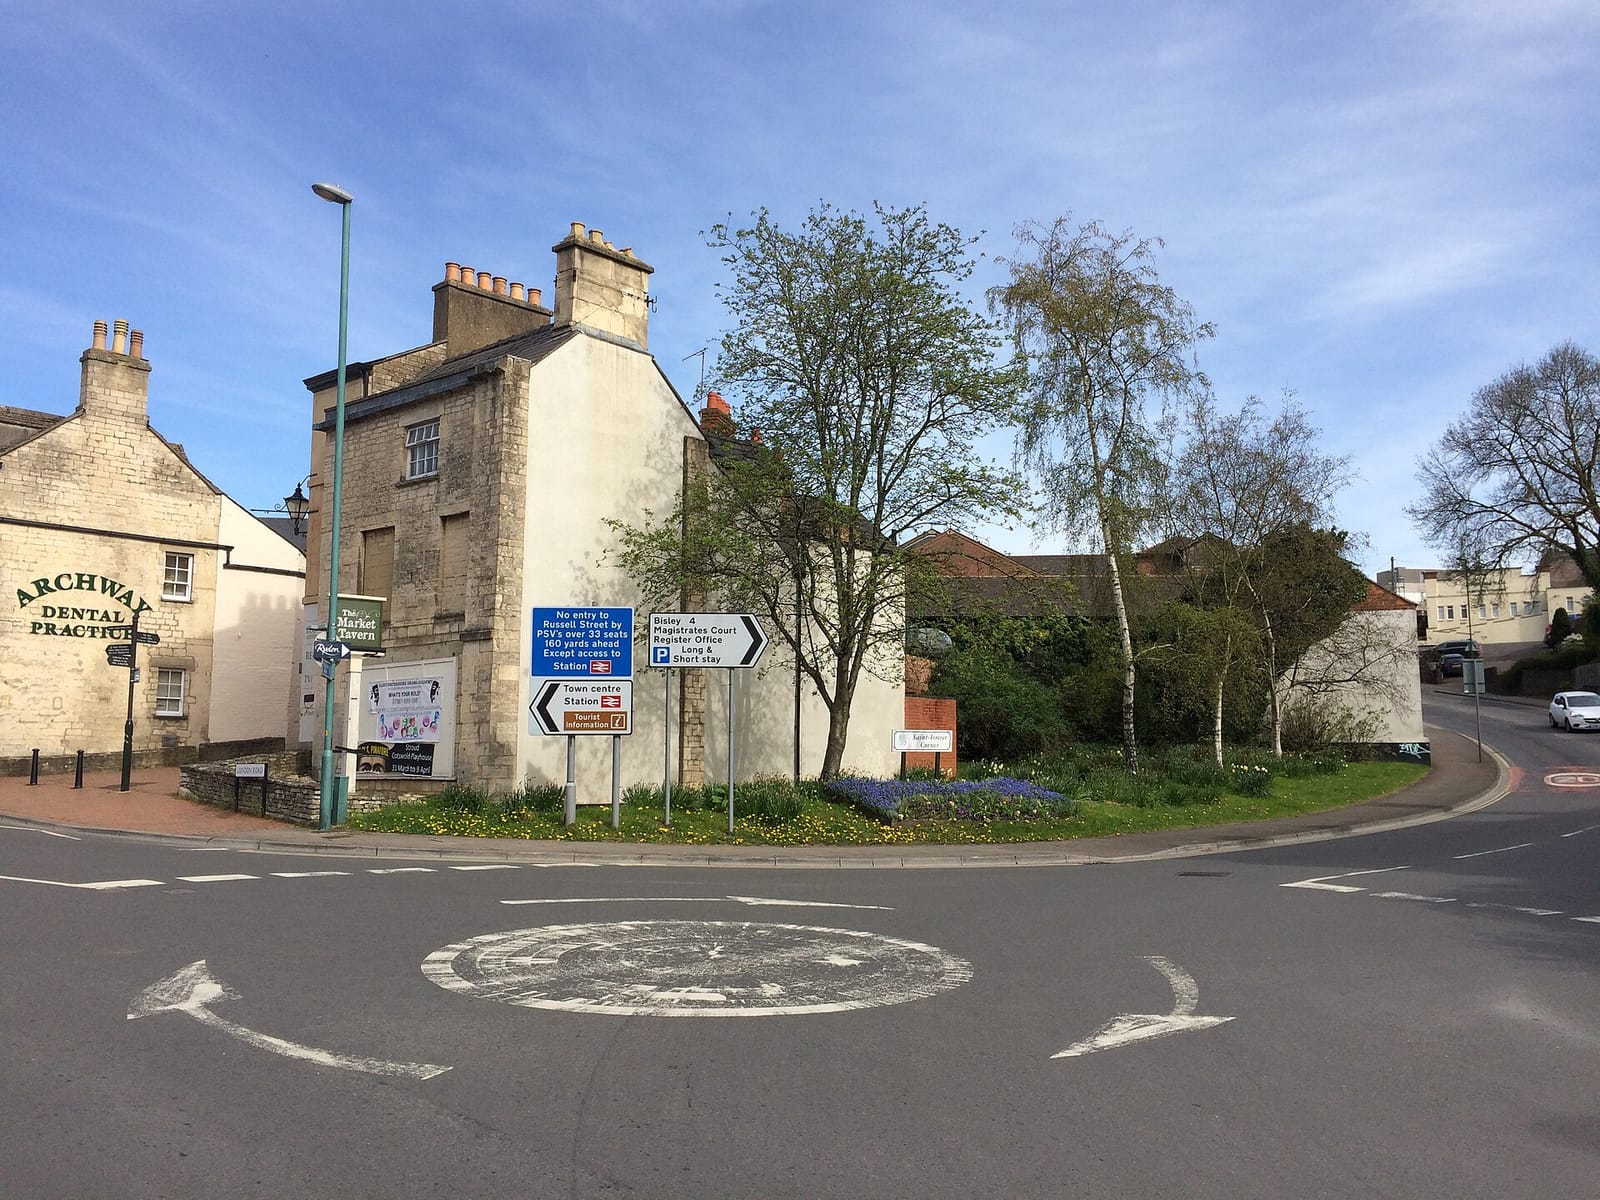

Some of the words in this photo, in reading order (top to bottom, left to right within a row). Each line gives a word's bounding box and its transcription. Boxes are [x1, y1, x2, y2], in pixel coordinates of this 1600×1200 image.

[16, 573, 152, 615] ARCHWAY
[41, 605, 125, 623] DENTAL
[342, 609, 358, 617] The
[556, 611, 570, 619] No
[572, 611, 597, 620] entry
[599, 611, 609, 619] to
[337, 617, 376, 629] Market
[543, 620, 576, 629] Russell
[579, 620, 608, 629] Street
[611, 620, 622, 630] by
[653, 616, 681, 626] Bisley
[689, 617, 696, 625] 4
[338, 628, 375, 640] Tavern
[537, 629, 562, 638] PSV's
[588, 630, 600, 638] 33
[603, 630, 628, 639] seats
[653, 626, 708, 635] Magistrates
[710, 626, 737, 635] Court
[545, 639, 561, 648] 160
[564, 640, 589, 649] yards
[591, 640, 619, 648] ahead
[653, 635, 692, 645] Register
[694, 635, 723, 644] Office
[543, 649, 575, 658] Except
[577, 650, 608, 658] access
[611, 649, 621, 657] to
[681, 646, 703, 654] Long
[706, 646, 713, 654] &
[673, 655, 699, 663] Short
[701, 655, 721, 664] stay
[553, 661, 587, 670] Station
[564, 684, 588, 693] Town
[590, 684, 621, 693] centre
[564, 697, 599, 706] Station
[391, 751, 410, 760] Cotswold
[411, 752, 432, 761] Playhouse
[420, 765, 431, 774] April
